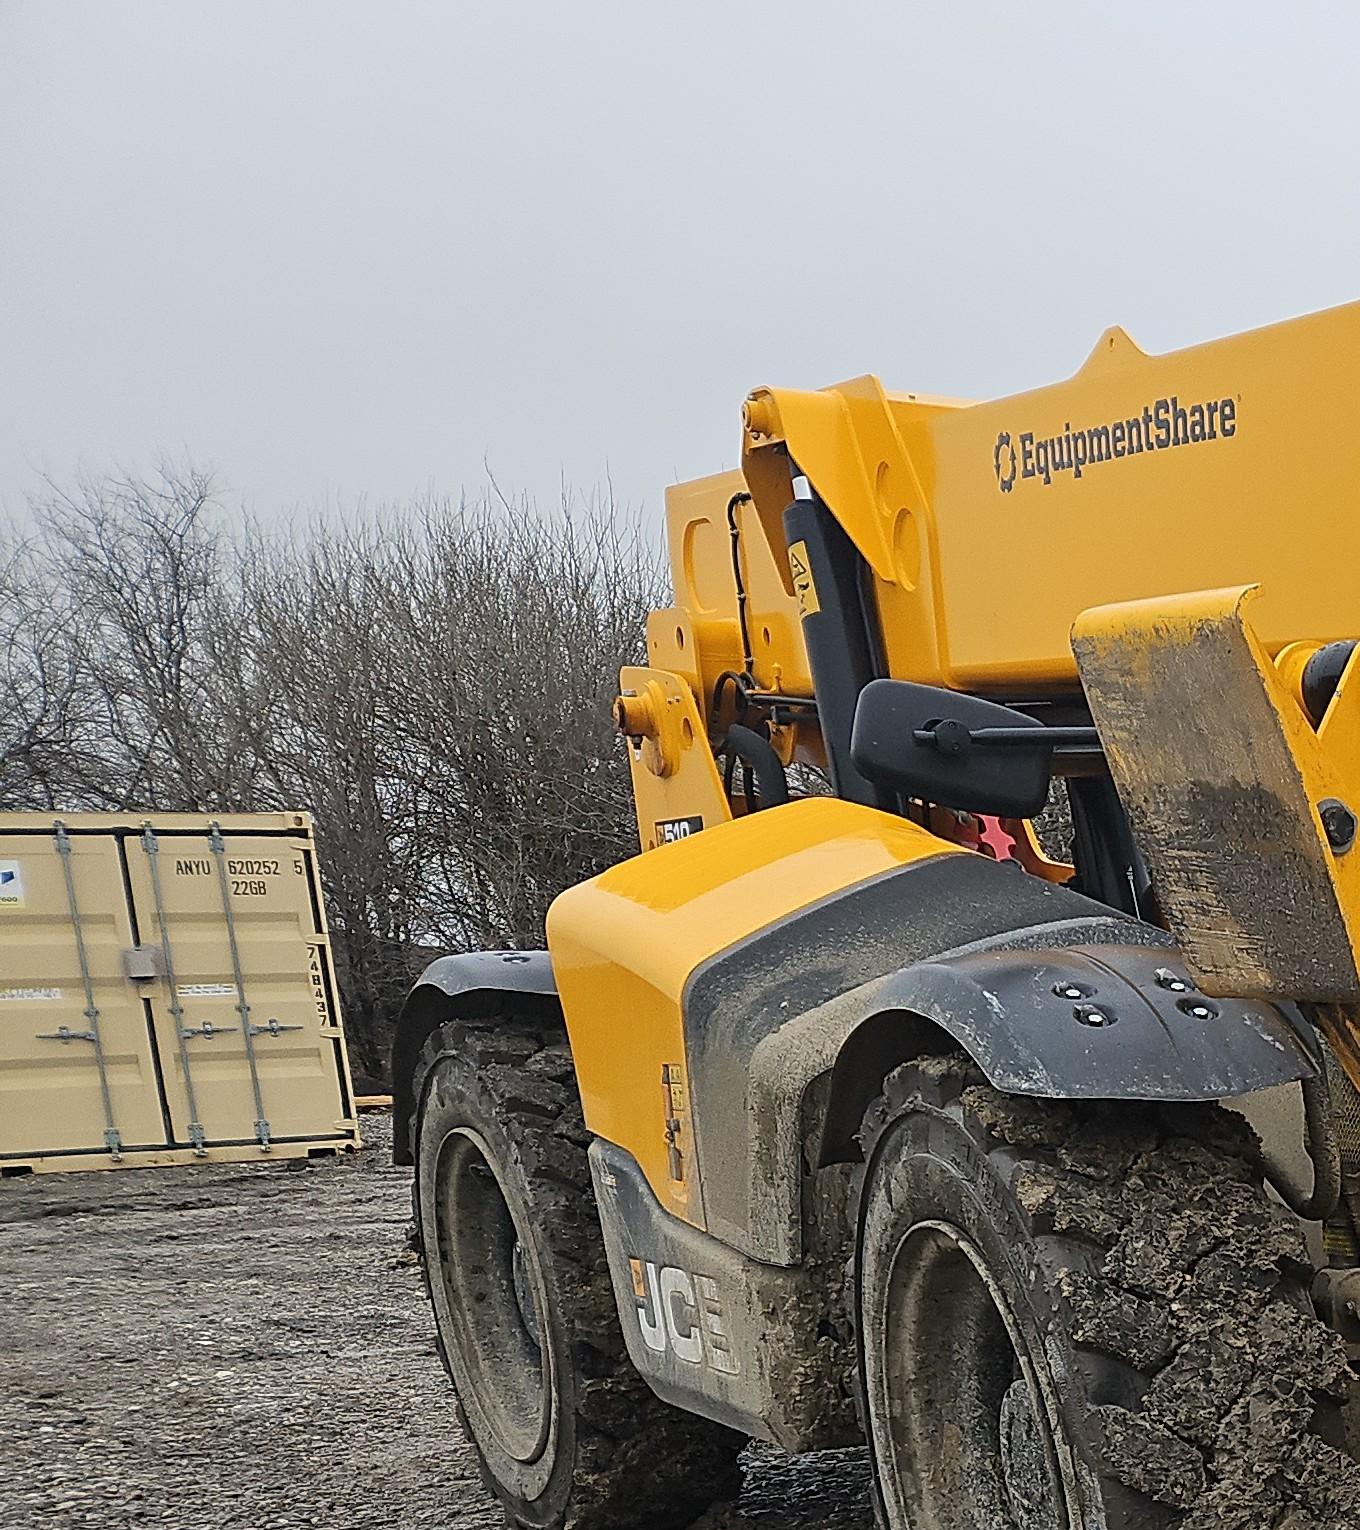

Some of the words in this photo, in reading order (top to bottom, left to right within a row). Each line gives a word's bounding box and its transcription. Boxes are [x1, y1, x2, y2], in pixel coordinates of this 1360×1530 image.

[1020, 396, 1237, 485] EquipmentShare
[176, 860, 211, 875] ANYU
[228, 860, 280, 875] 620252
[294, 860, 303, 875] 5
[231, 880, 267, 896] 22GB
[636, 1260, 740, 1376] JCB
